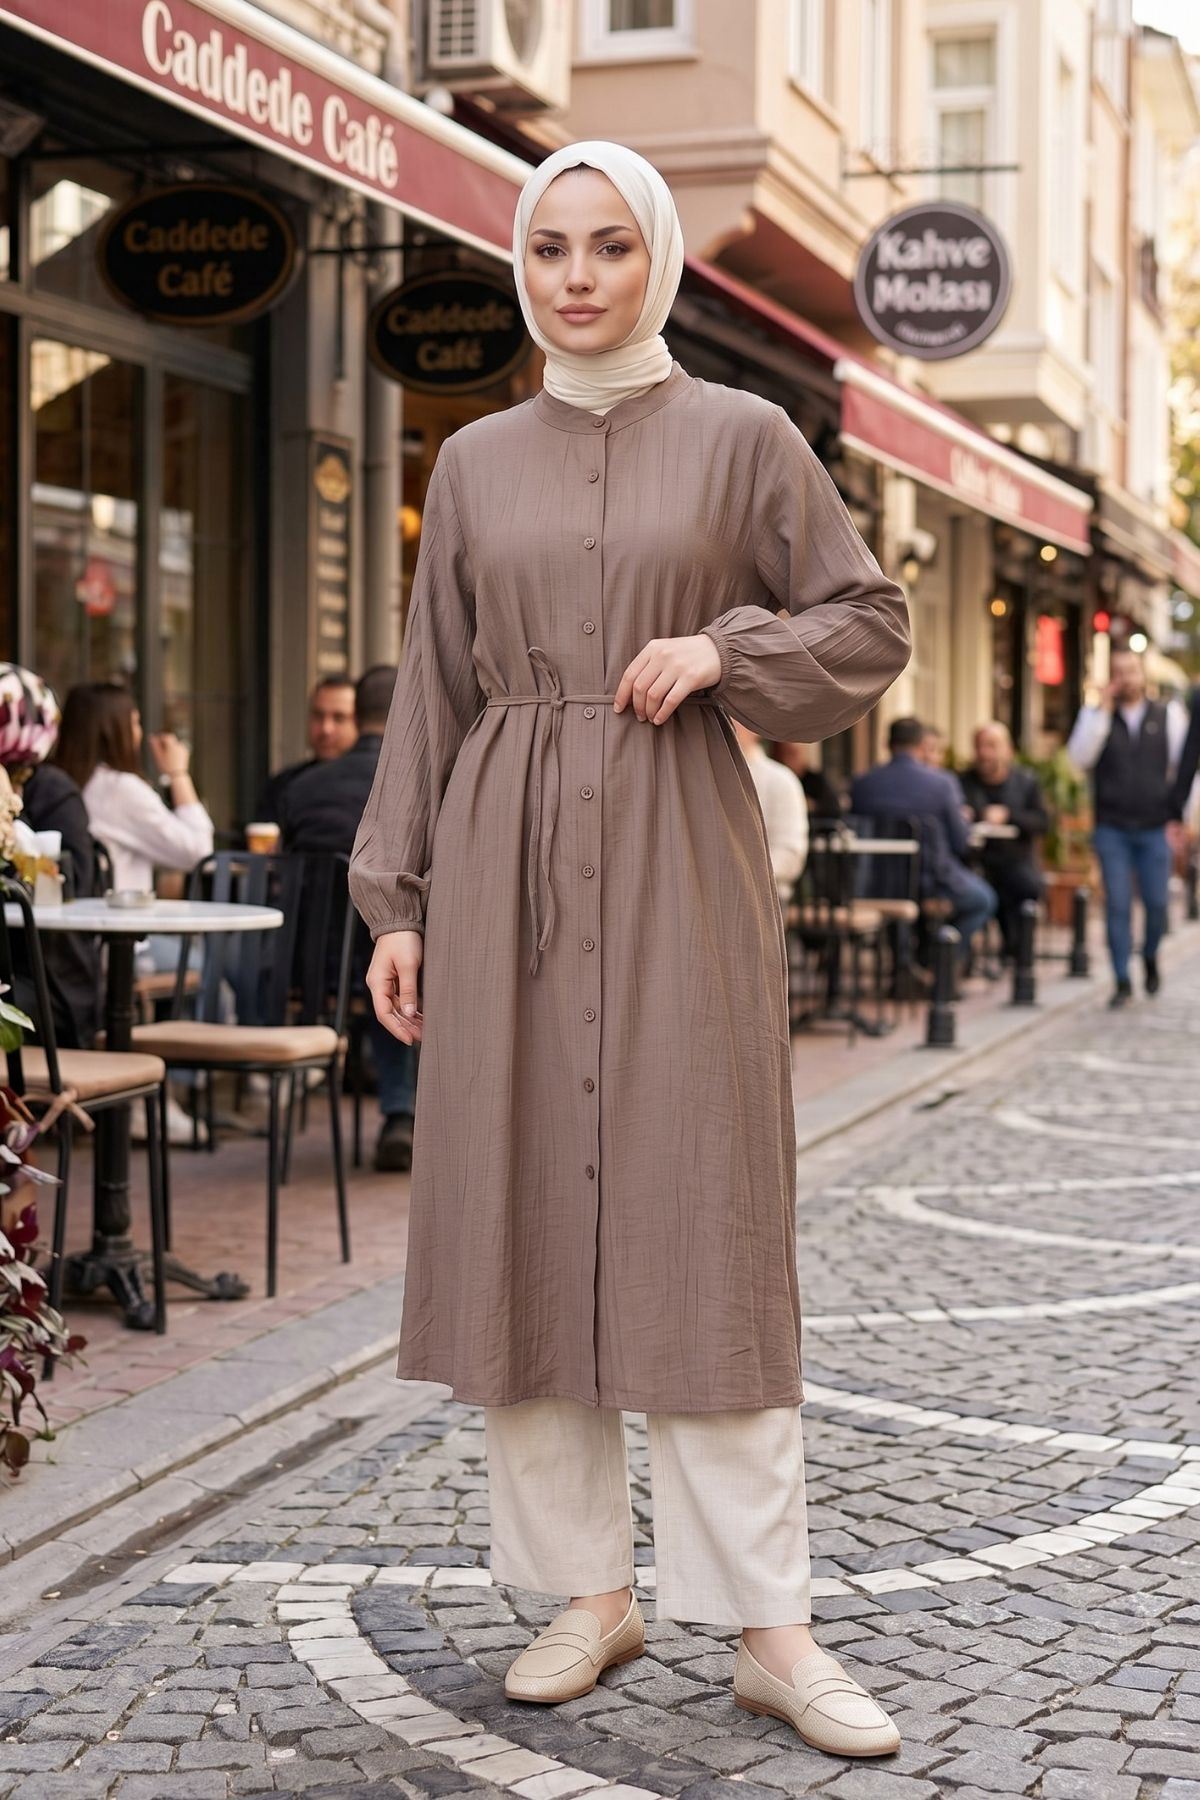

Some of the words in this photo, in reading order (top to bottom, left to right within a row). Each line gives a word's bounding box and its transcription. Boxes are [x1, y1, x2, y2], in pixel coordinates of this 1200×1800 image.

[142, 0, 313, 146] Caddede
[323, 95, 398, 188] Café
[124, 218, 269, 253] Caddede
[877, 228, 991, 270] Kahve
[158, 262, 234, 297] Café
[387, 301, 514, 336] Caddede
